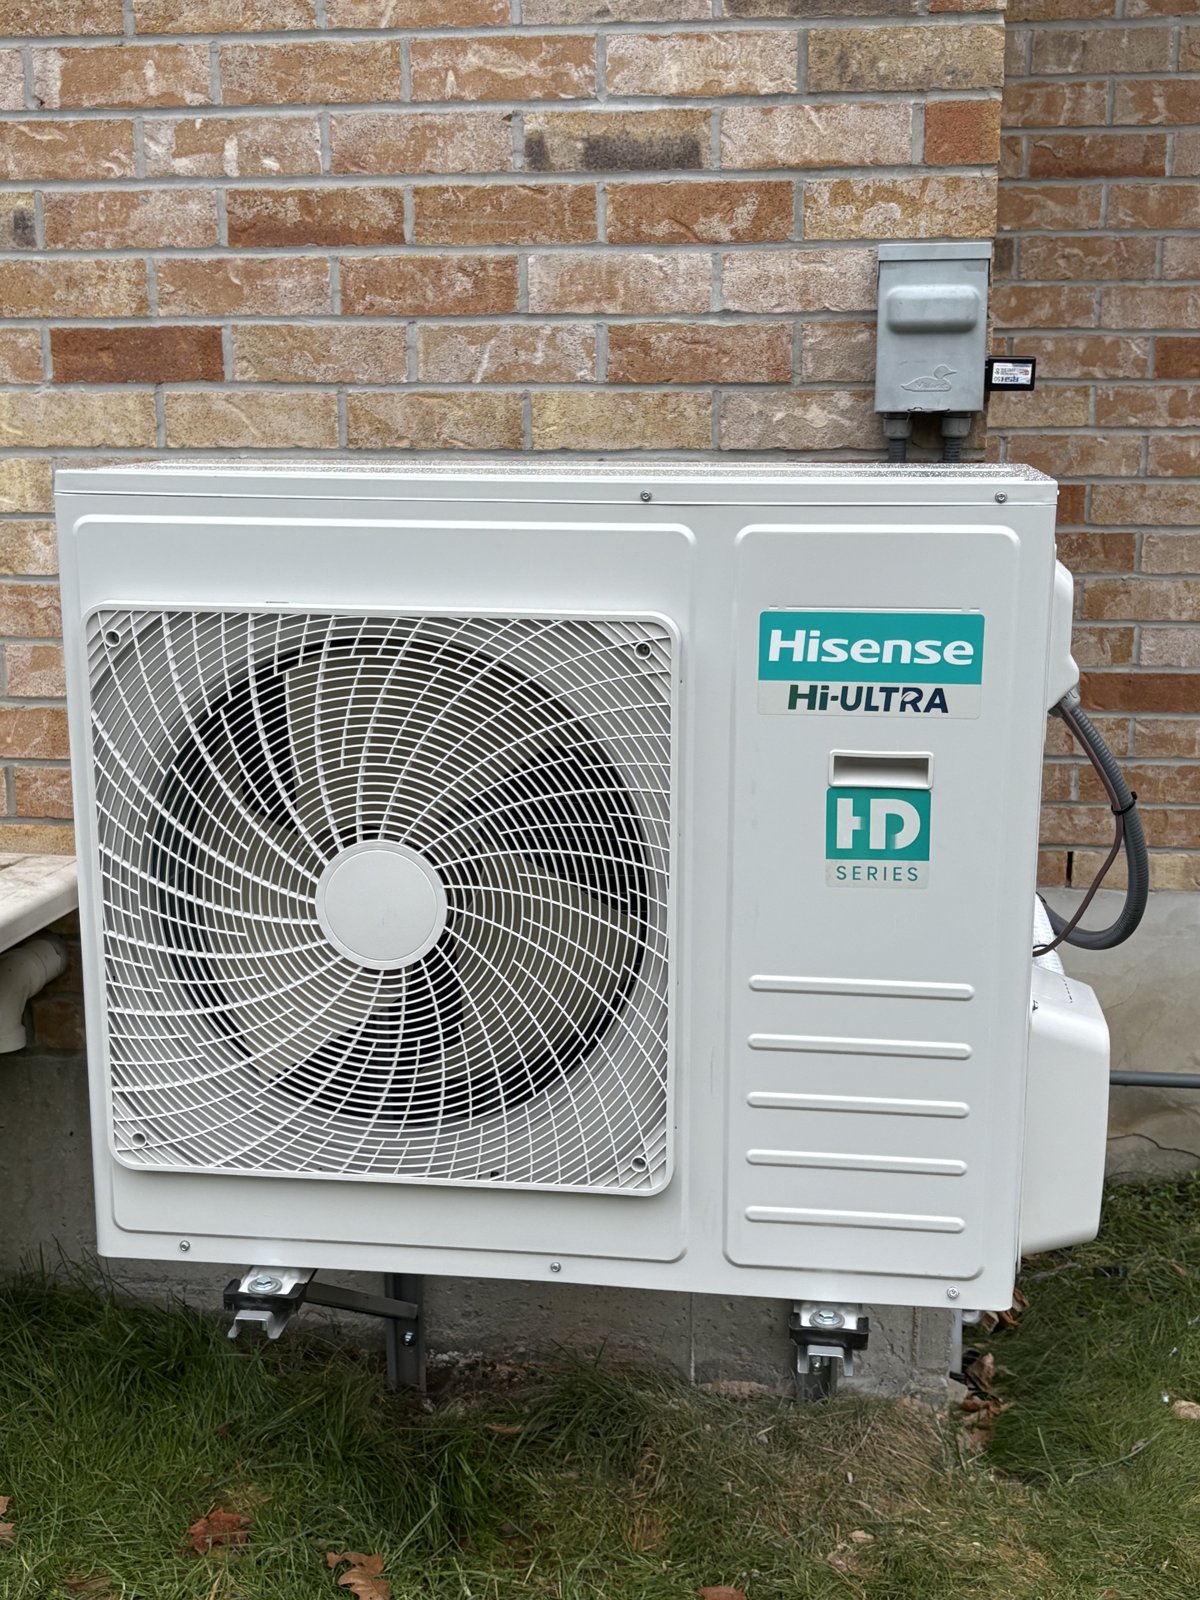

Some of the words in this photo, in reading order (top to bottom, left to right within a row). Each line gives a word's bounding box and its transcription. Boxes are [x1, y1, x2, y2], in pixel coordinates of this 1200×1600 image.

[768, 629, 974, 666] Hisense
[787, 684, 949, 714] Hi-ULTRA
[836, 797, 921, 850] HD
[836, 865, 919, 882] SERIES
